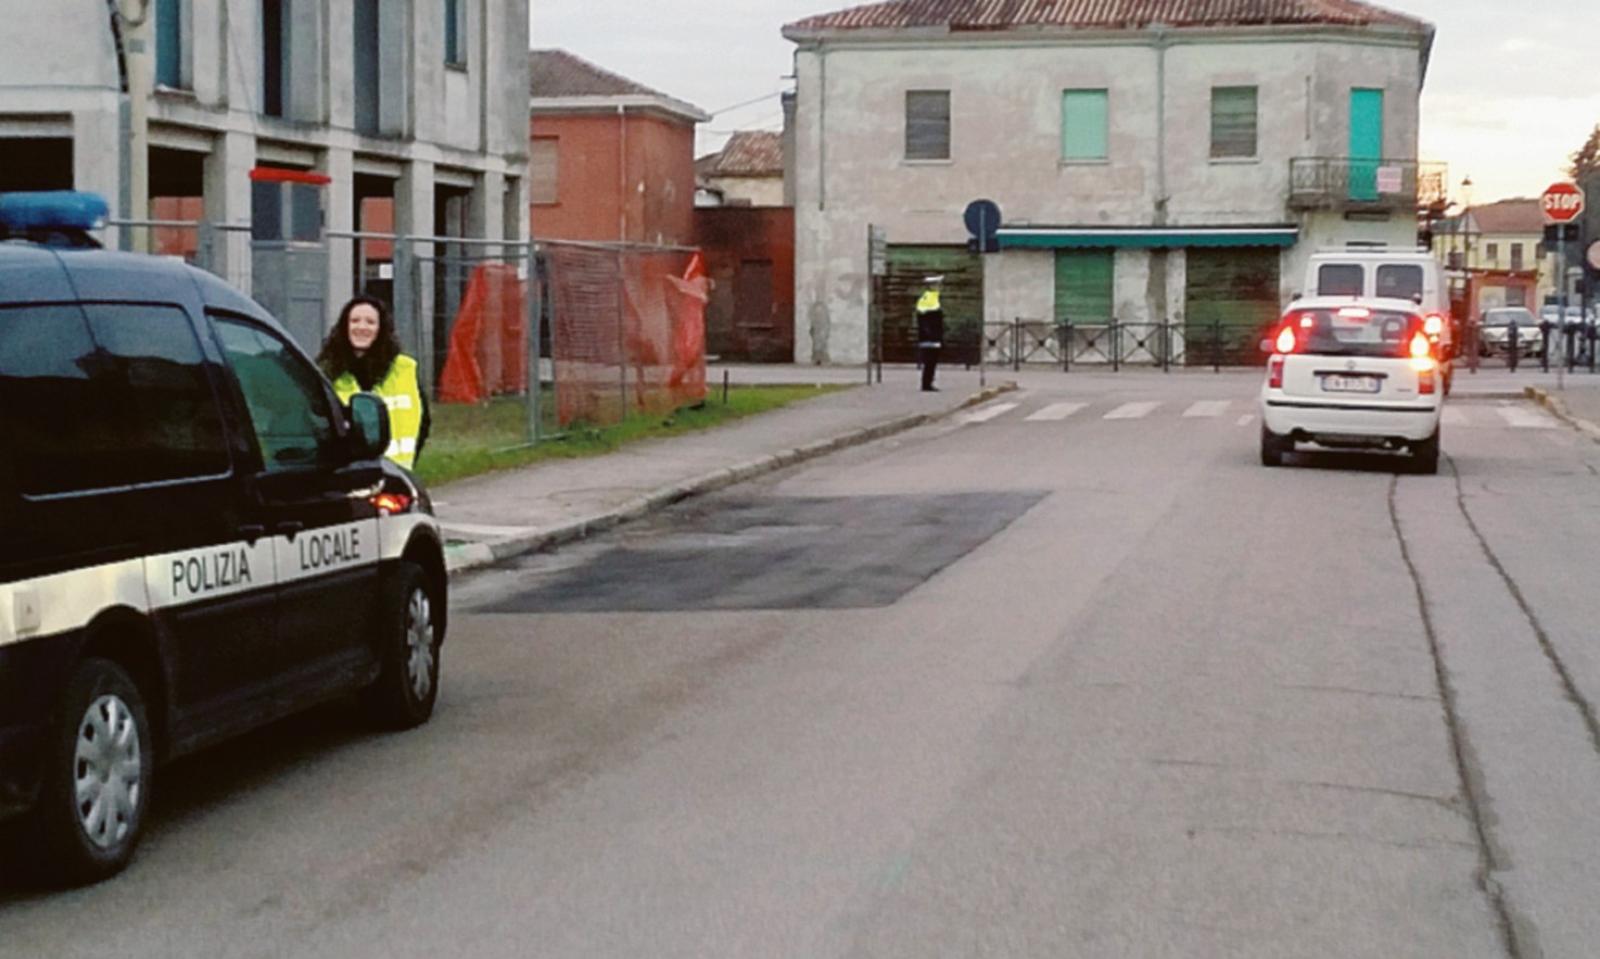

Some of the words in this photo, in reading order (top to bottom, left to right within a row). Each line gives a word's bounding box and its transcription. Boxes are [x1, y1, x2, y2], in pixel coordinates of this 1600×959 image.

[1545, 193, 1580, 210] STOP
[172, 548, 251, 596] POLIZIA
[300, 527, 361, 571] LOCALE
